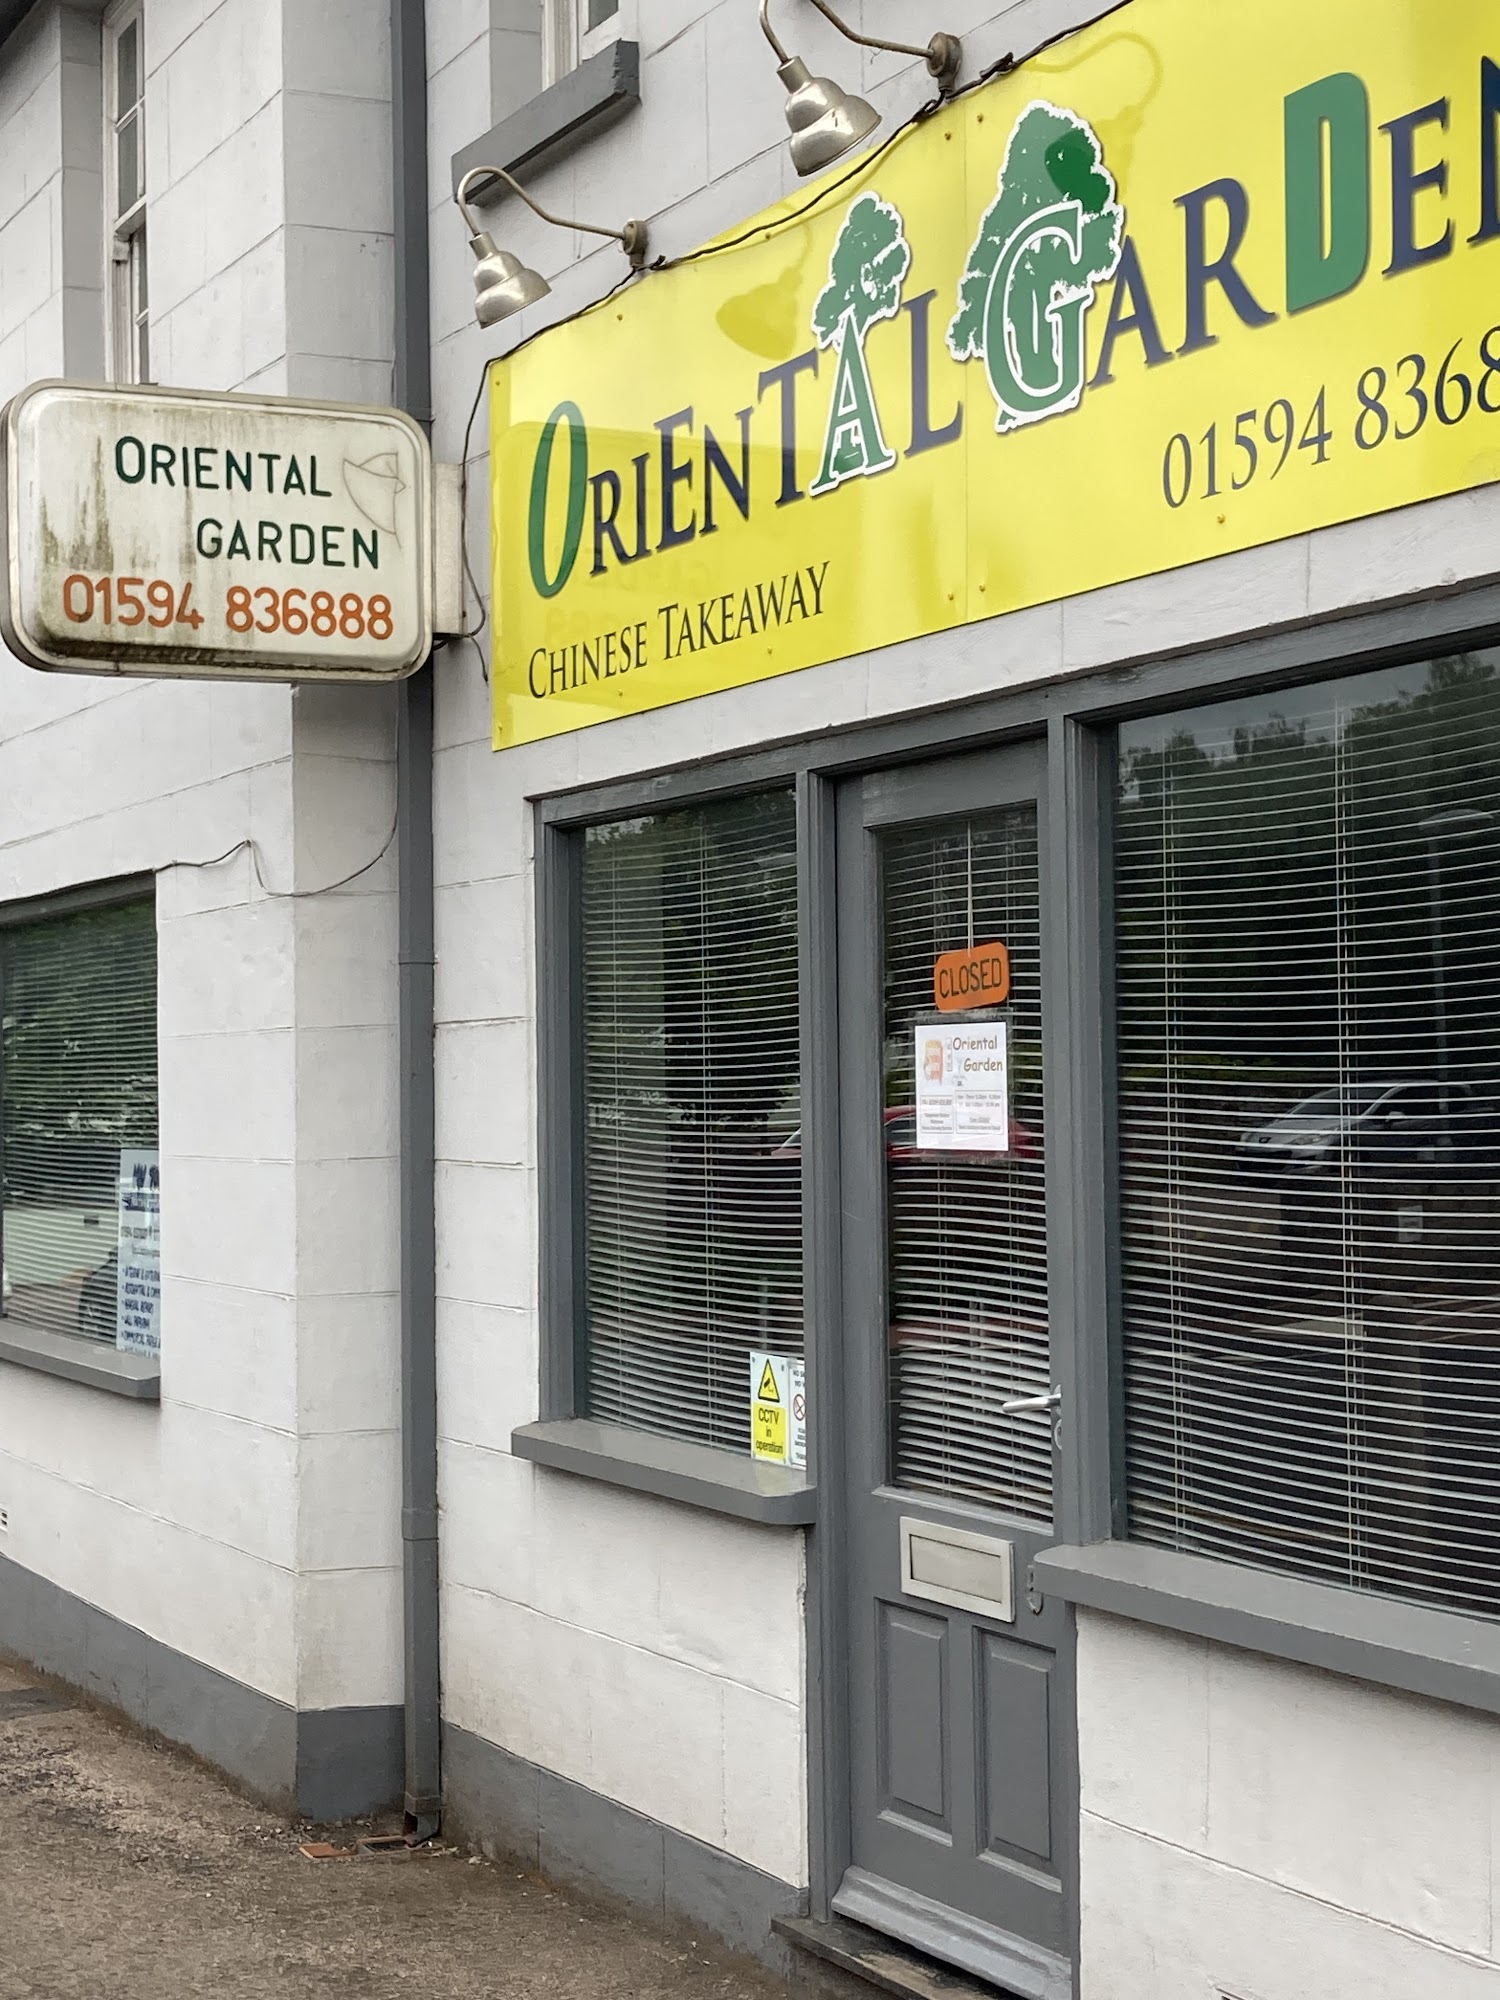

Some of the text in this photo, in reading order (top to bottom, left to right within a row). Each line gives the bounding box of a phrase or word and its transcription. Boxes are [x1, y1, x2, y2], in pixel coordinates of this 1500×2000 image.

[115, 435, 332, 498] ORIENTAL
[527, 288, 964, 598] ORIENTAL
[1162, 384, 1332, 509] 01594
[196, 517, 380, 569] GARDEN
[63, 574, 395, 640] 01594 836888
[528, 561, 831, 699] CHINESE TAKEAWAY
[938, 957, 1002, 999] CLOSED
[953, 1035, 998, 1051] Oriental
[963, 1057, 1003, 1072] Garden
[758, 1407, 779, 1425] CCTV
[766, 1426, 772, 1438] in
